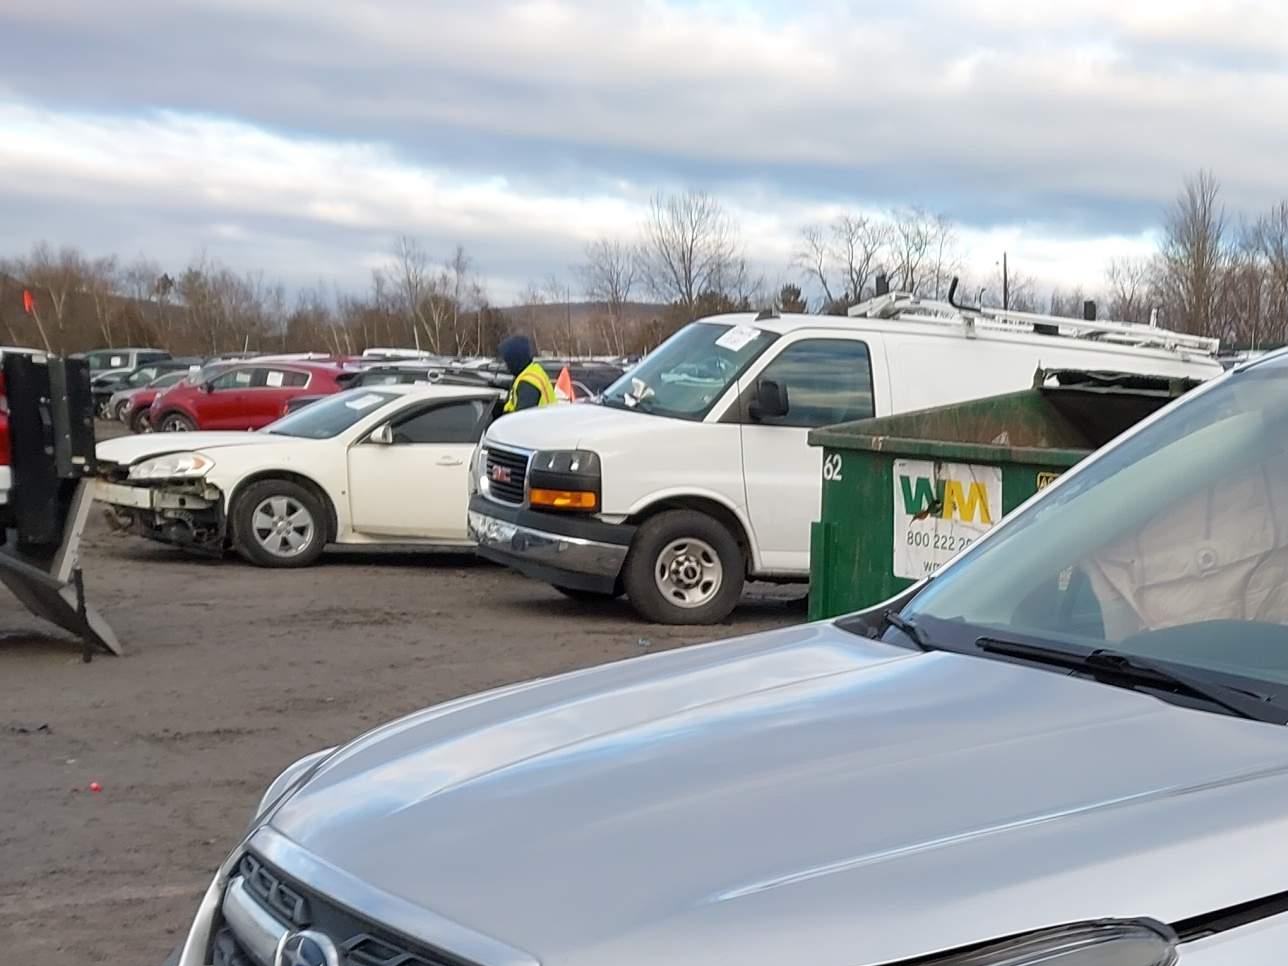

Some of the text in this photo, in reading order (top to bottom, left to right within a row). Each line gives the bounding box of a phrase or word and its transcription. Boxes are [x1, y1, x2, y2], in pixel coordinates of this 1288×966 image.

[824, 454, 842, 480] 62
[900, 475, 992, 524] WM
[907, 530, 929, 548] 800
[933, 534, 955, 551] 222
